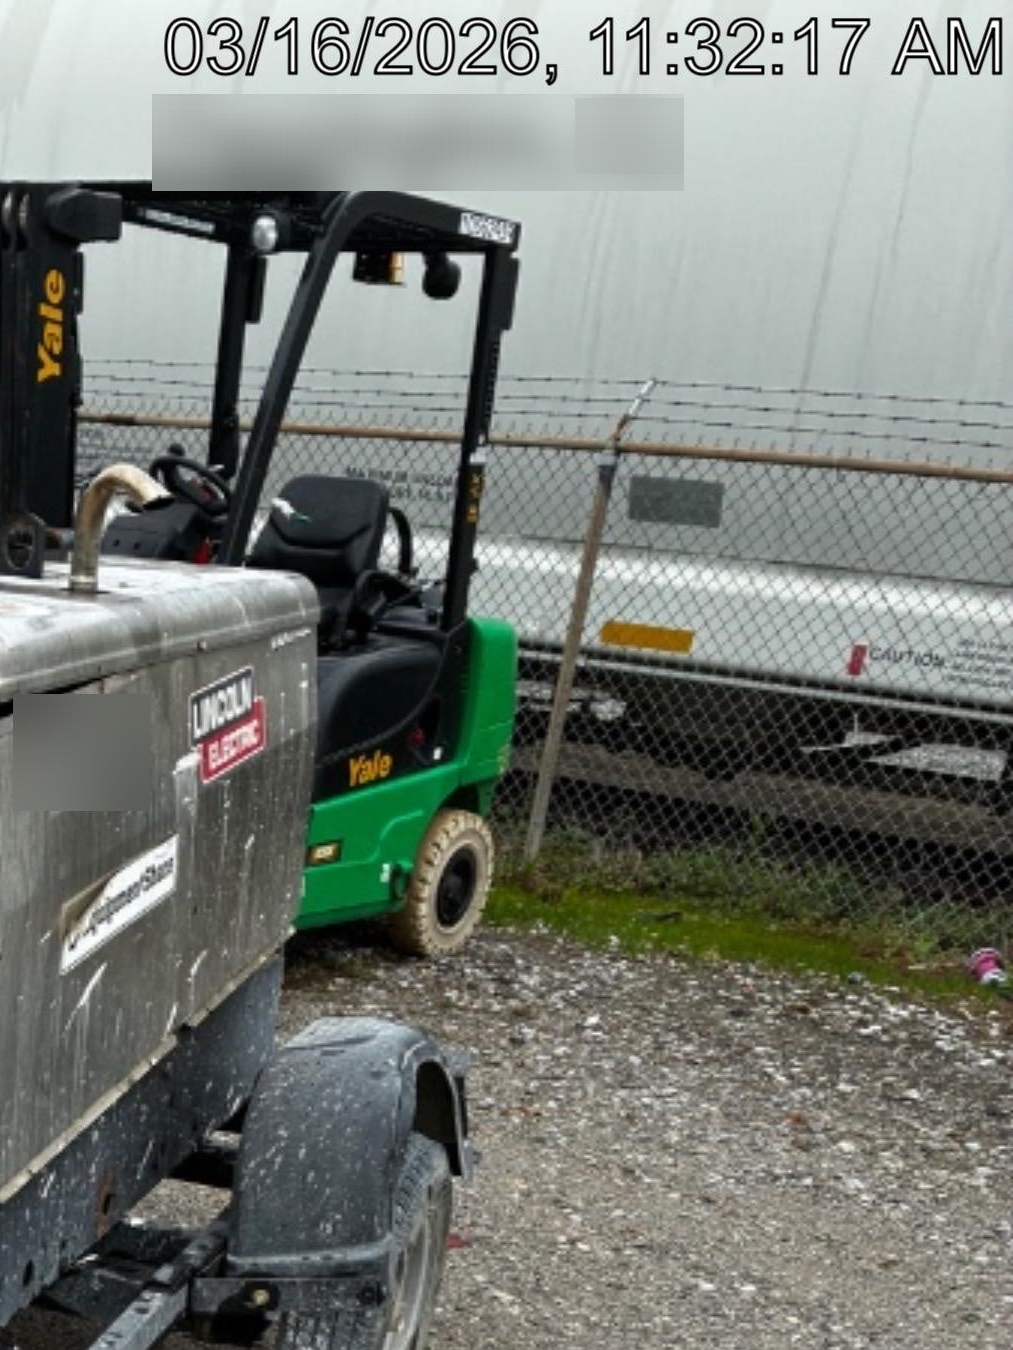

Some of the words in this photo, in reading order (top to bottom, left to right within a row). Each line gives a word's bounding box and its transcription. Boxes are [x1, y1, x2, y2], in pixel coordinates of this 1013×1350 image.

[37, 269, 66, 382] Yale
[192, 676, 253, 739] LINCOLN
[208, 718, 260, 771] ELECTRIC
[349, 749, 393, 787] Yale
